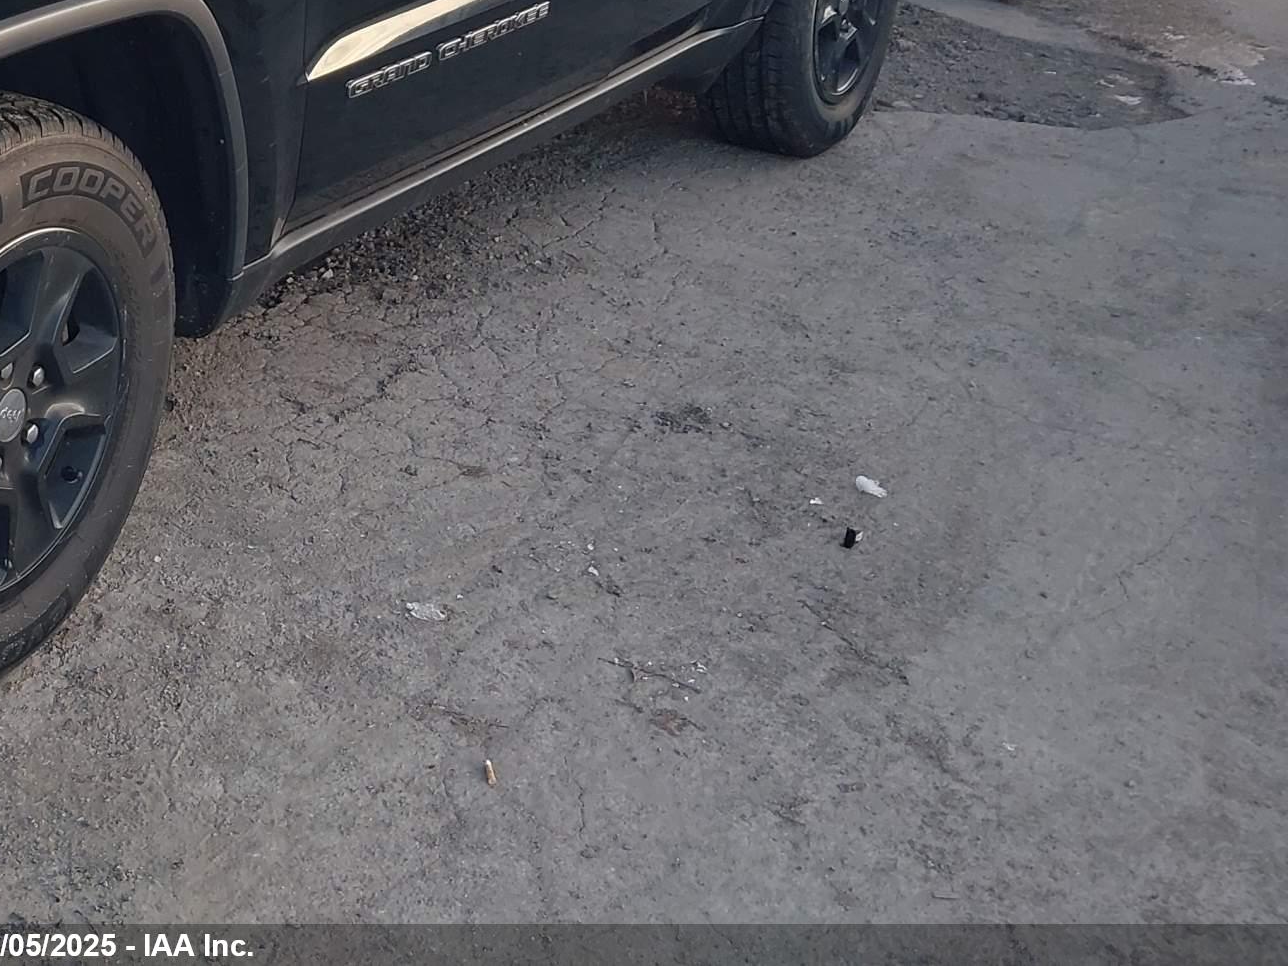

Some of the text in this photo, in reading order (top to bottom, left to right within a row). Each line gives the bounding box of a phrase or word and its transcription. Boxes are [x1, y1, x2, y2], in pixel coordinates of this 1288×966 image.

[346, 1, 551, 98] GRAND CHEROKEE
[27, 166, 158, 248] COOPER
